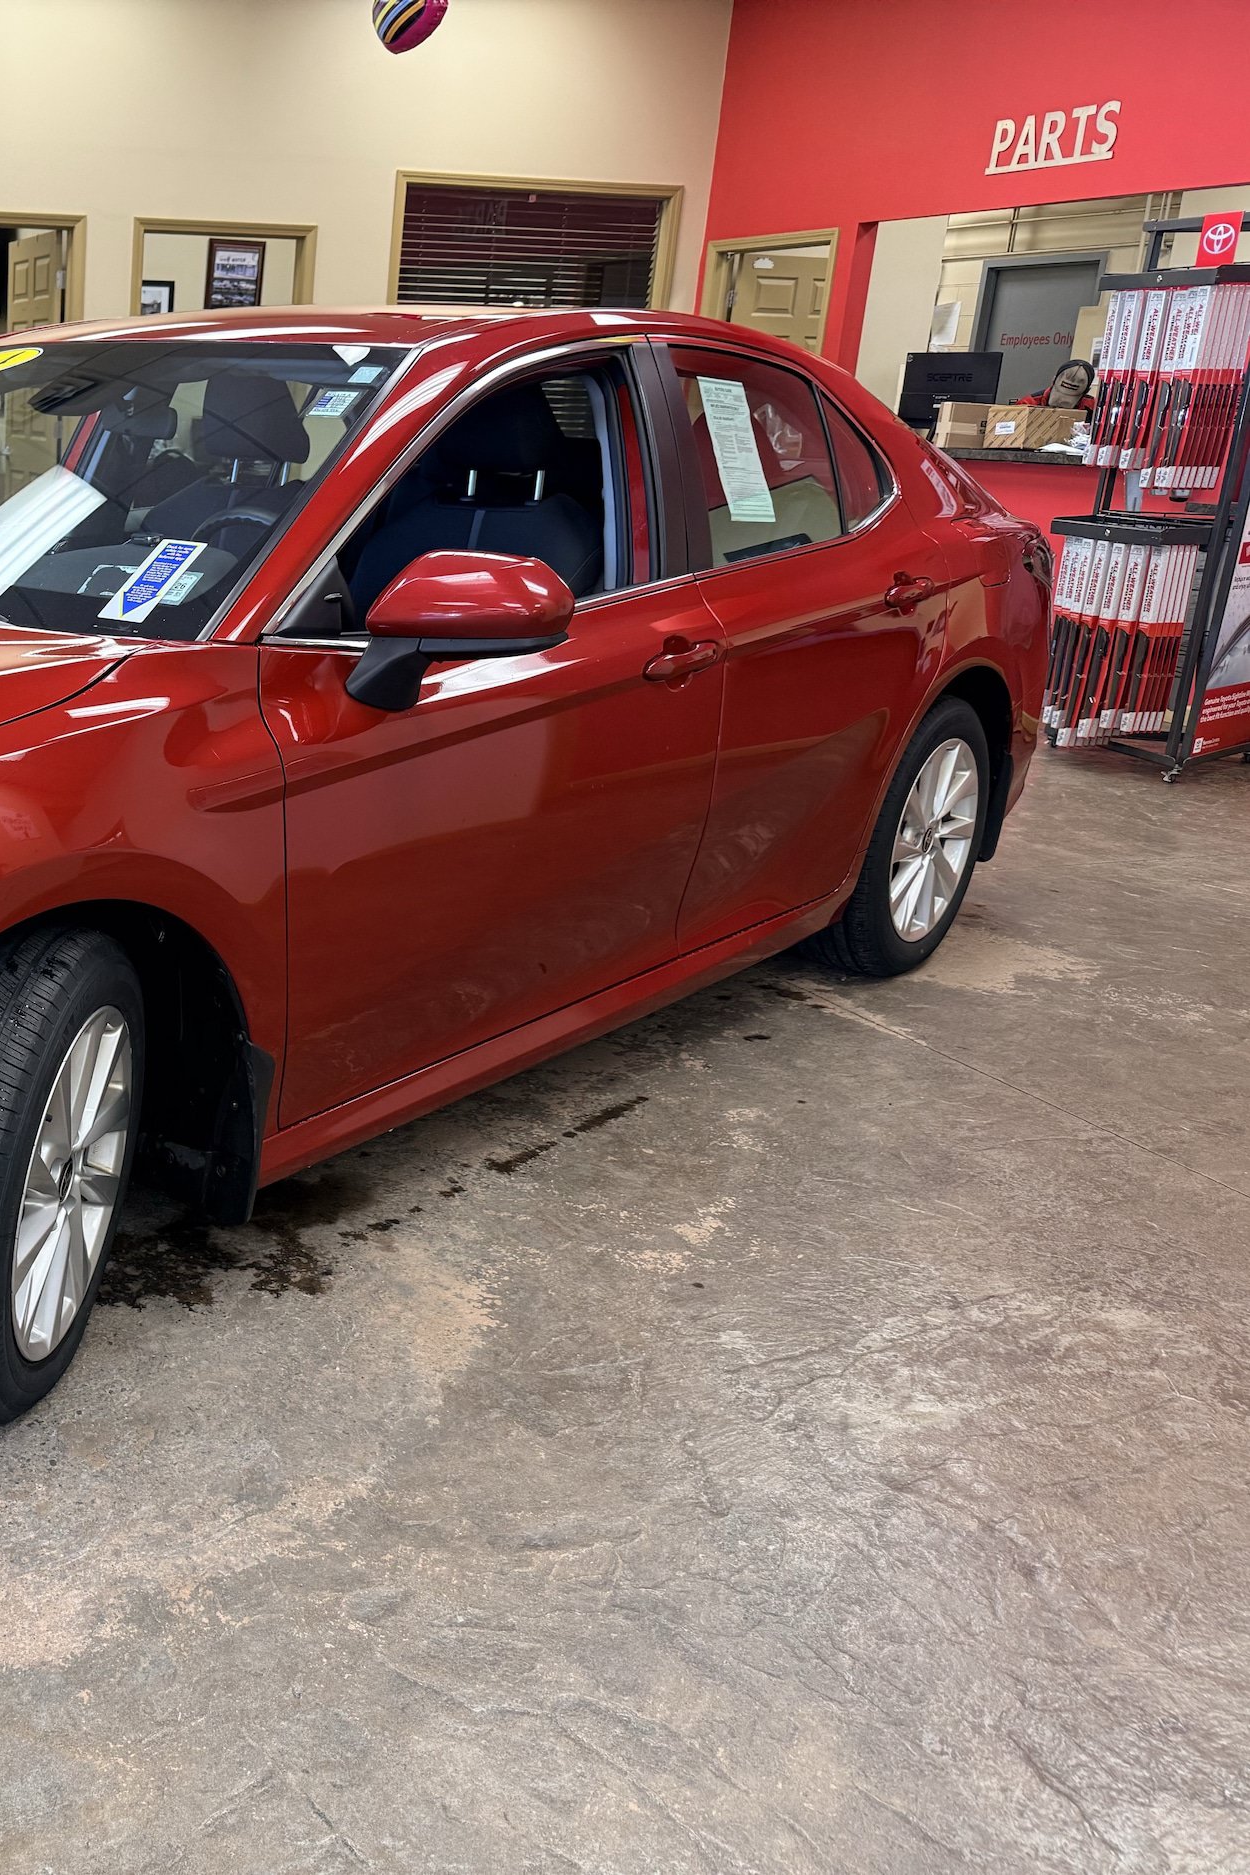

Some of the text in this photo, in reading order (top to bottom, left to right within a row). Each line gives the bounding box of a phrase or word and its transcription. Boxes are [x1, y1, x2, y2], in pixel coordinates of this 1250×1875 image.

[987, 100, 1122, 169] PARTS
[1000, 331, 1075, 349] Employees Only
[1119, 309, 1132, 360] ALL-WEATHER
[1144, 308, 1159, 361] ALL-WEATHER
[1168, 308, 1182, 361] ALL-WEATHER
[927, 373, 975, 382] SCEPTRE
[1089, 557, 1103, 606] ALL-WEATHER
[1105, 560, 1119, 610] ALL-WEATHER
[1125, 561, 1139, 612] ALL-WEATHER
[1145, 562, 1159, 613] ALL-WEATHER
